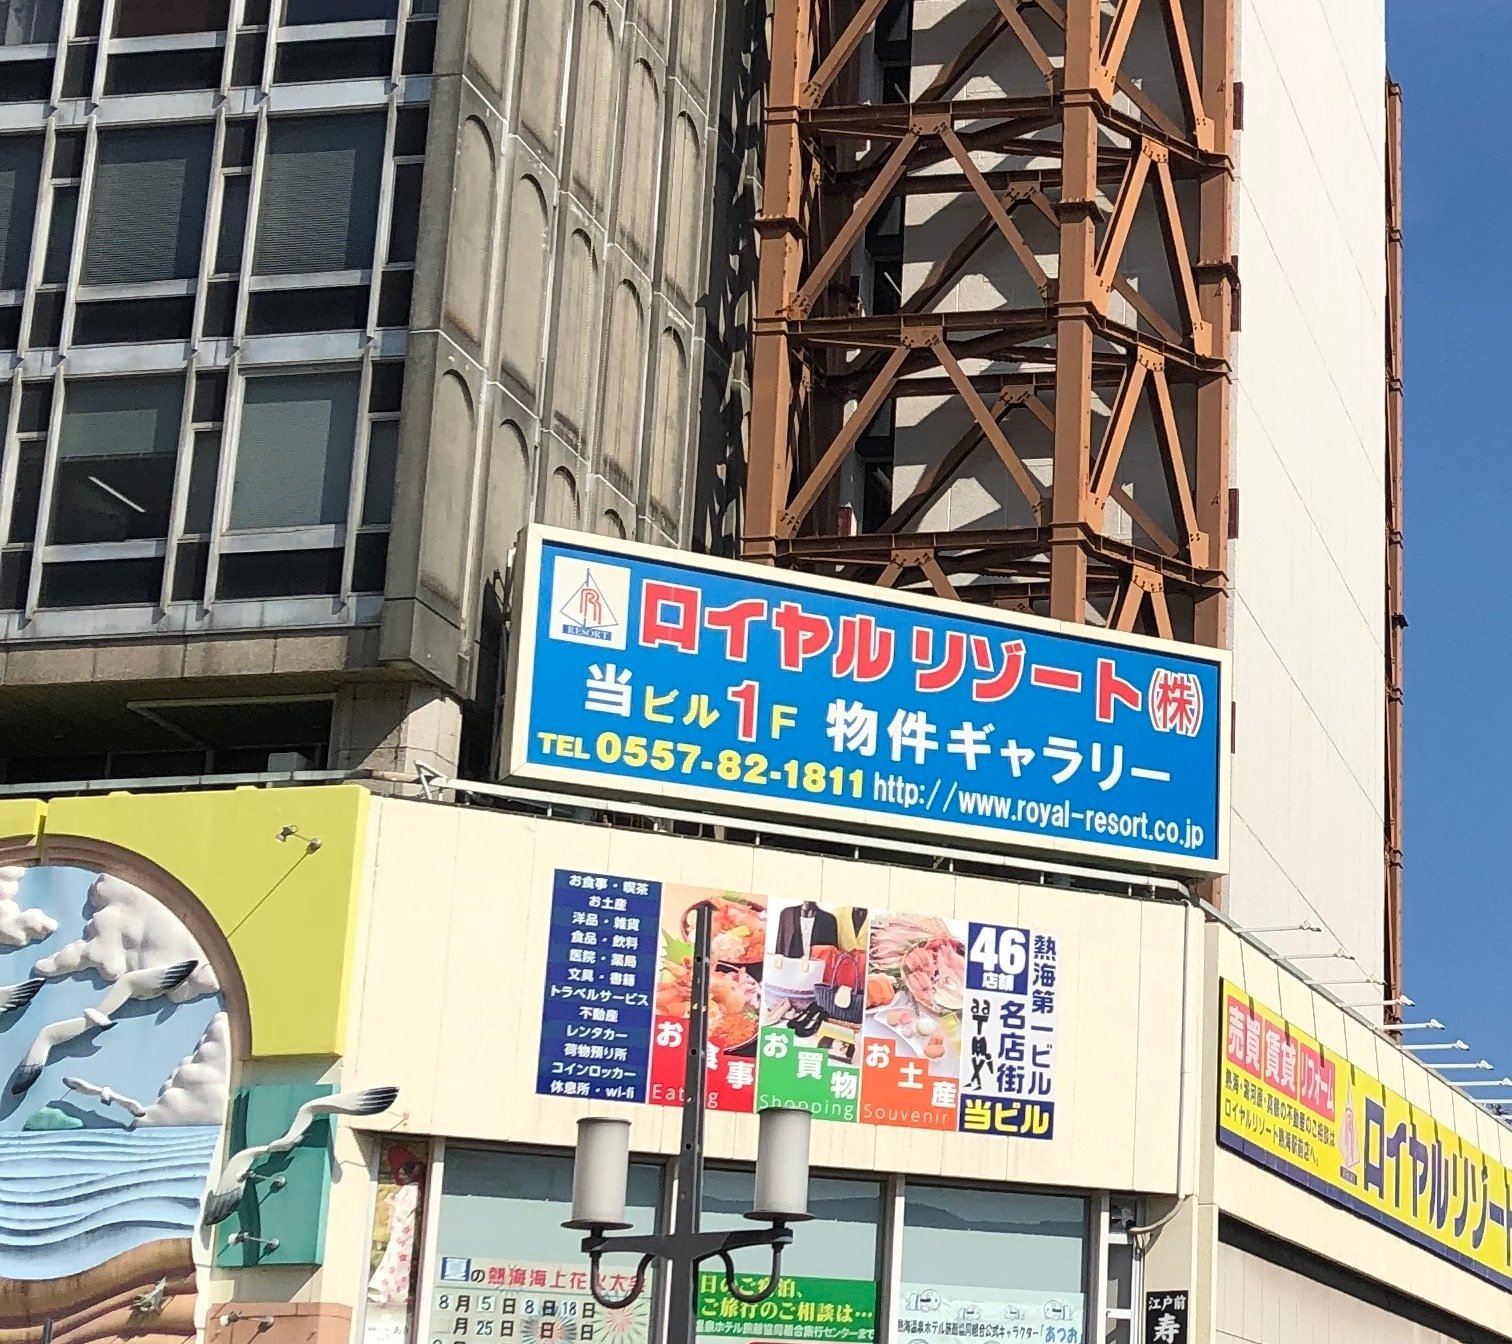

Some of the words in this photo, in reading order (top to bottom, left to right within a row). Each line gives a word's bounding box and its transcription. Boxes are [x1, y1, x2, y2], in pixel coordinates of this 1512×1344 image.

[639, 579, 896, 682] ロイヤル
[585, 663, 798, 743] 当ビル1F
[826, 698, 1171, 792] 物件ギャラリー
[537, 731, 591, 761] TEL
[596, 731, 865, 799] 0557-82-1811
[873, 771, 1204, 850] http://www.royal-resort.co.jp
[568, 874, 650, 896] お食事・喫茶
[588, 895, 628, 912] お土産
[571, 912, 641, 932] 洋品・雑貨
[570, 930, 639, 951] 食品・飲料
[971, 926, 1027, 975] 46
[568, 949, 638, 969] 医院・薬局
[567, 967, 637, 987] 文具・書籍
[982, 973, 1015, 991] 店舗
[550, 985, 650, 1007] トラベルサービス
[578, 1006, 619, 1023] 不動産
[1028, 934, 1057, 1096] 熱海第一ビル
[566, 1024, 628, 1041] レンタカー
[996, 1000, 1026, 1095] 名店街
[1228, 1005, 1261, 1071] 売買
[1265, 1028, 1296, 1092] 賃貸
[551, 1061, 637, 1080] コインロッカー
[763, 1032, 859, 1101] お買物
[865, 1042, 958, 1109] お土産
[652, 1083, 719, 1109] Eatg
[863, 1102, 949, 1126] Souvenir
[963, 1098, 1050, 1136] 当ビル
[1148, 1296, 1187, 1311] 江戸前
